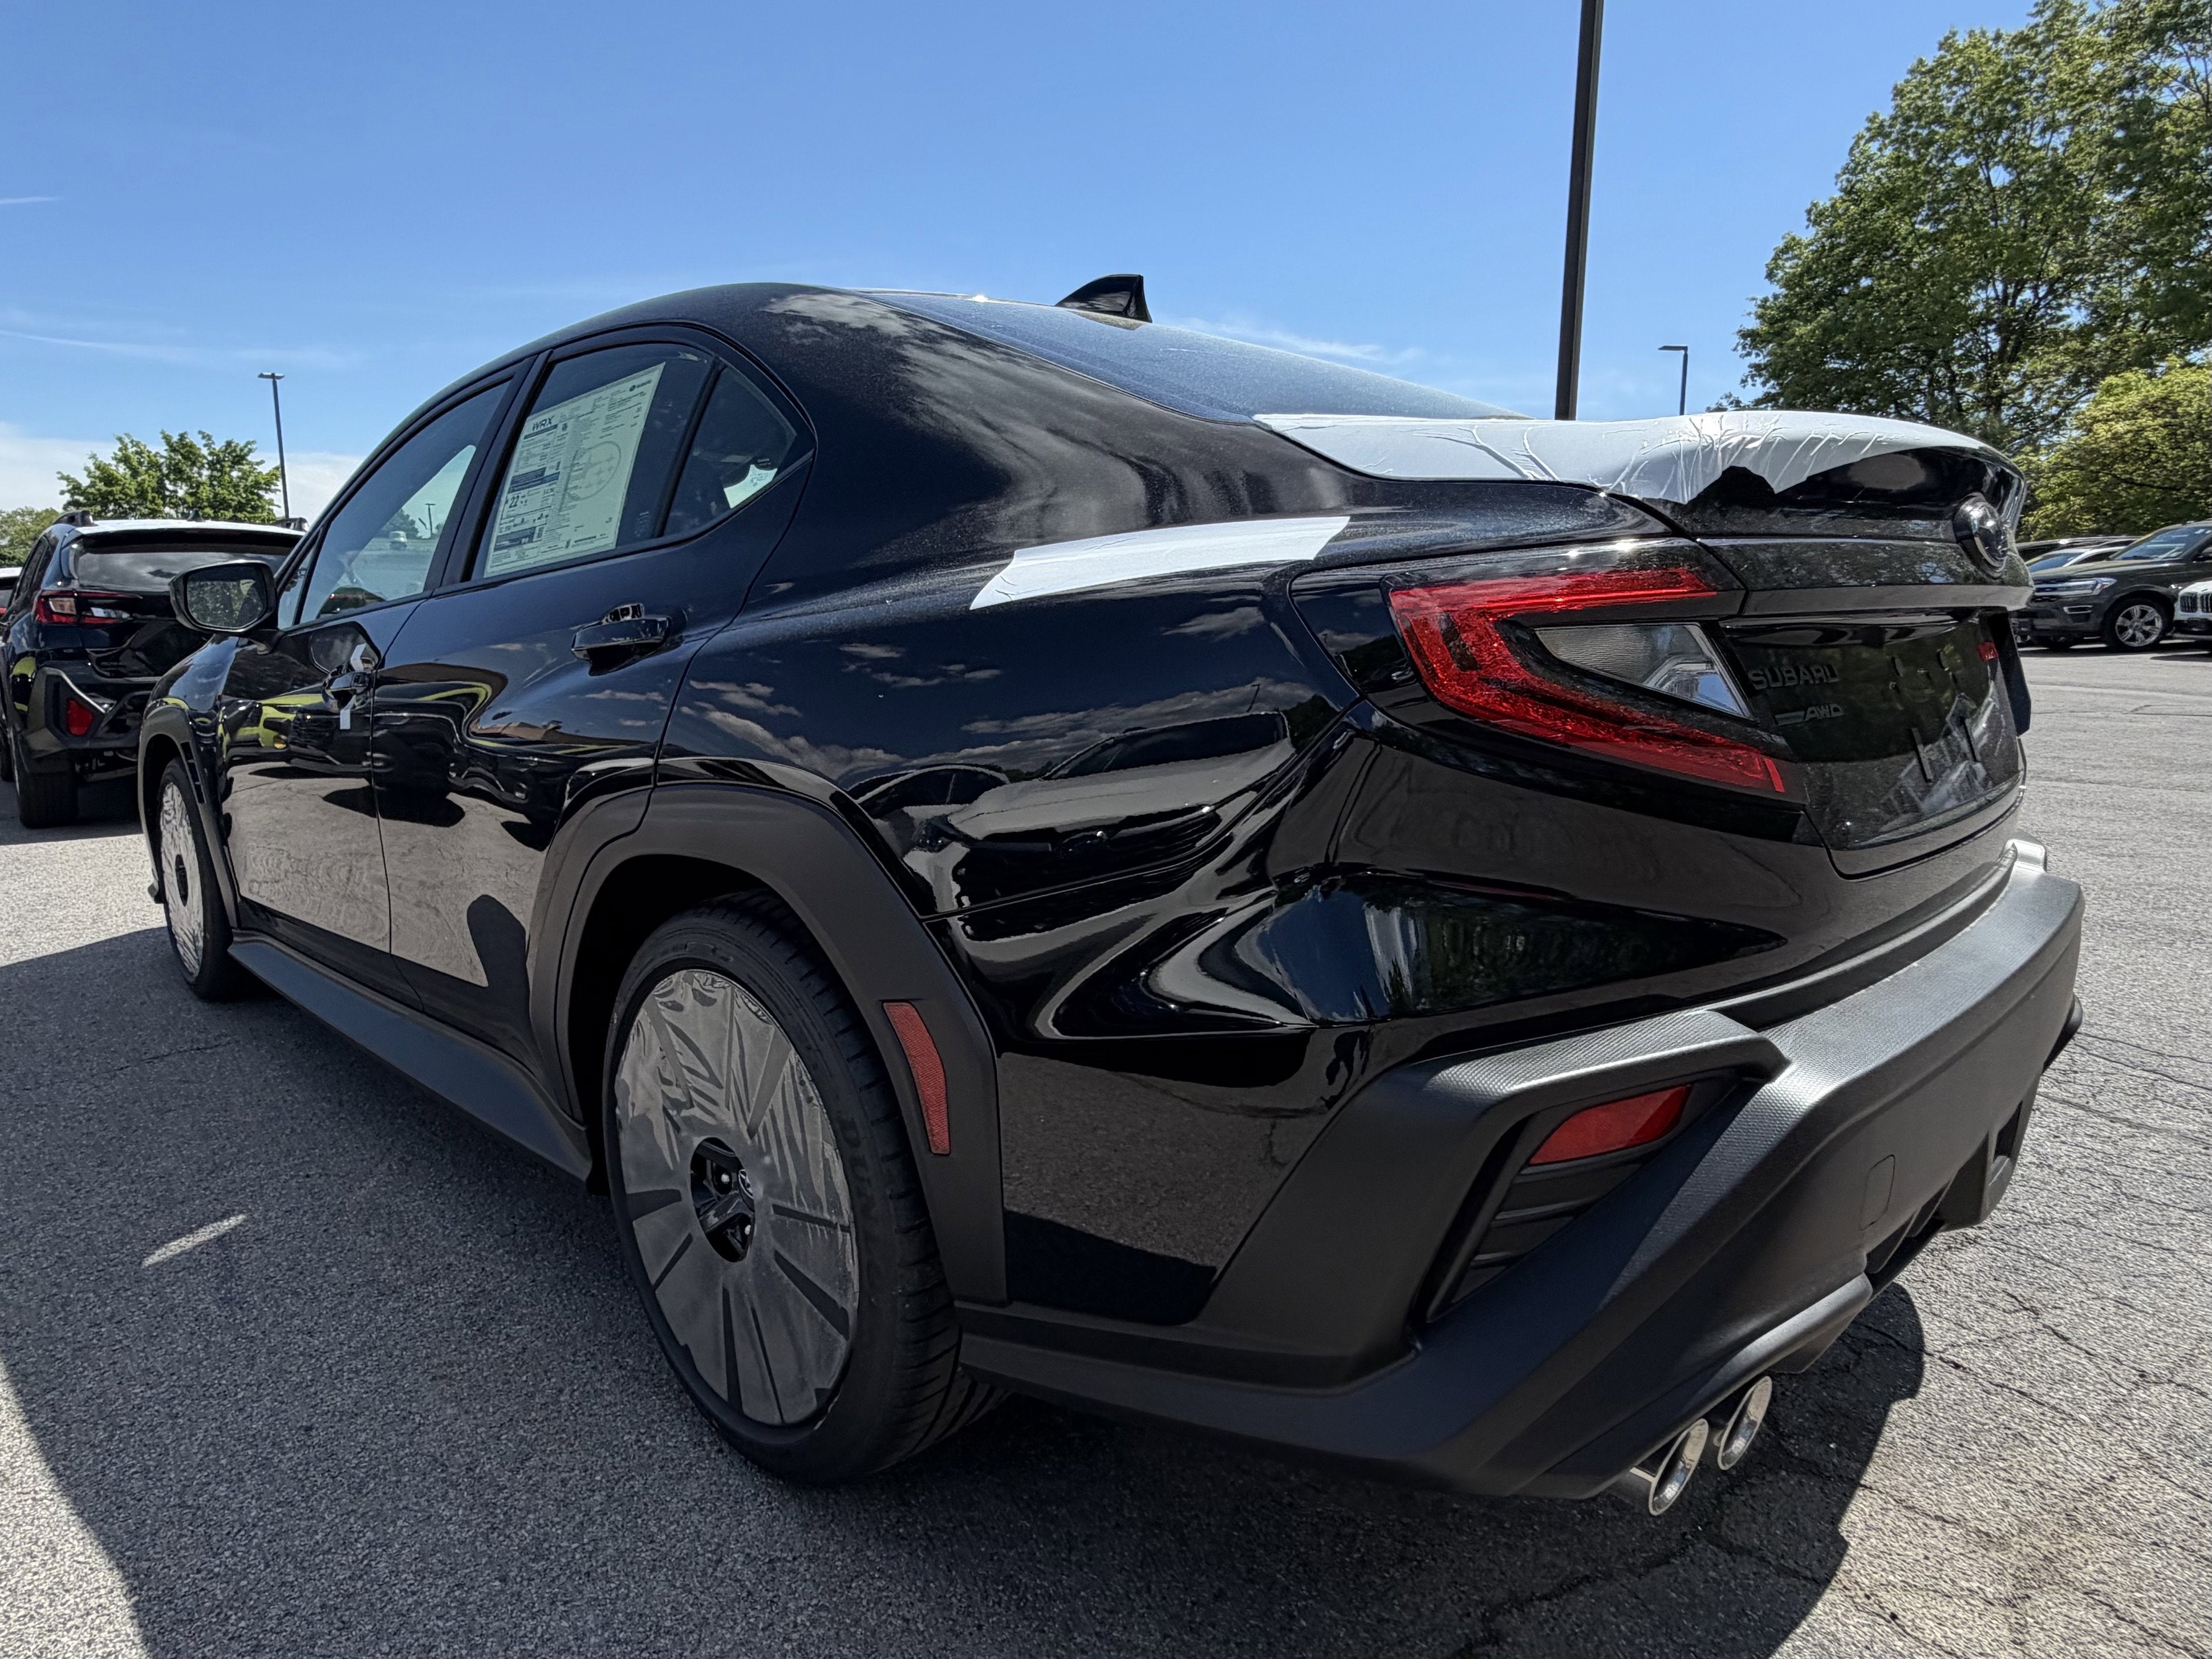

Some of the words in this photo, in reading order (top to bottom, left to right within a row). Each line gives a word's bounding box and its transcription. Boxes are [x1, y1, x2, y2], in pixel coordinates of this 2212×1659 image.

[533, 415, 555, 431] WRX
[1748, 664, 1841, 690] SUBARU
[1803, 703, 1845, 722] AWD
